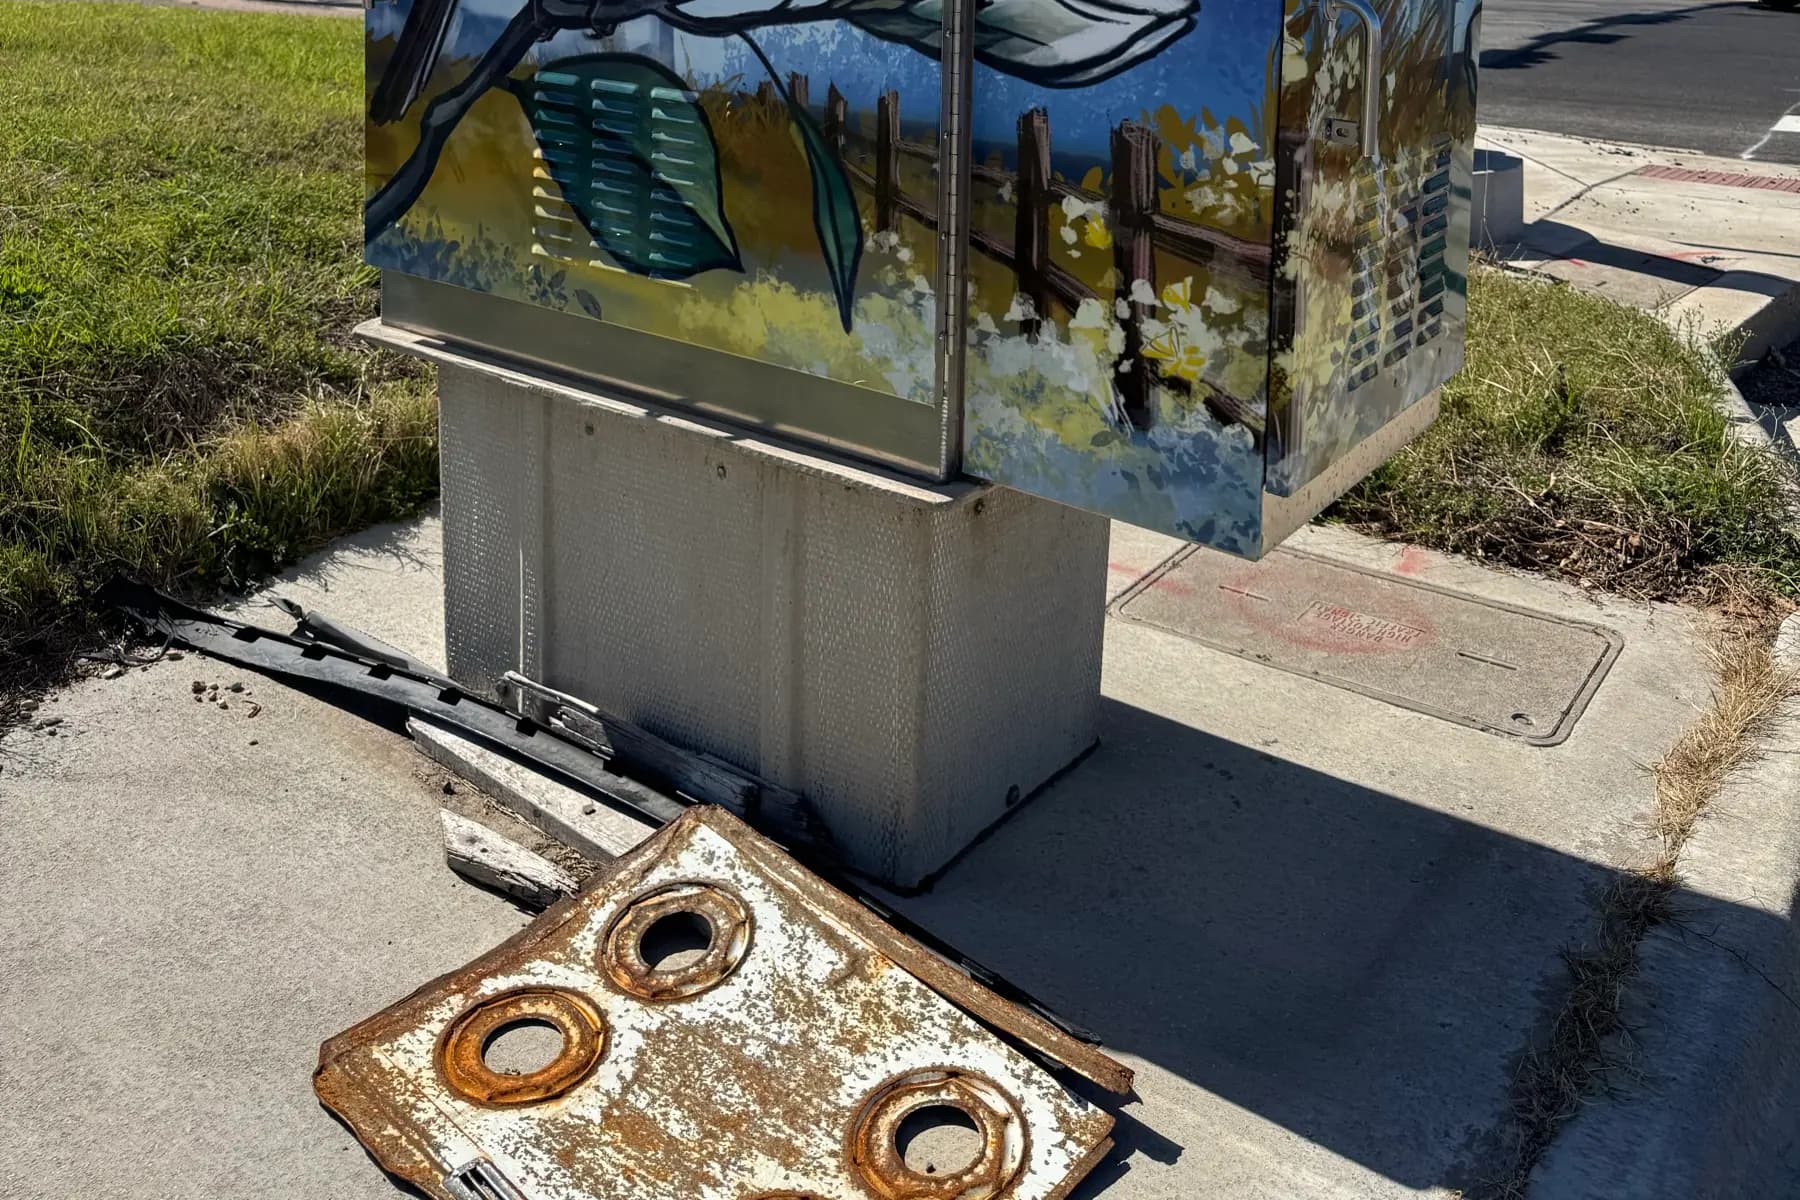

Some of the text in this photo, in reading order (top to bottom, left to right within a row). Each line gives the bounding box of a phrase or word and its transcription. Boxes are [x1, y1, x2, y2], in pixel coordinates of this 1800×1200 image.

[1330, 622, 1383, 642] DANGER
[1366, 618, 1421, 638] TRAFFIC
[1377, 628, 1412, 643] HIGH
